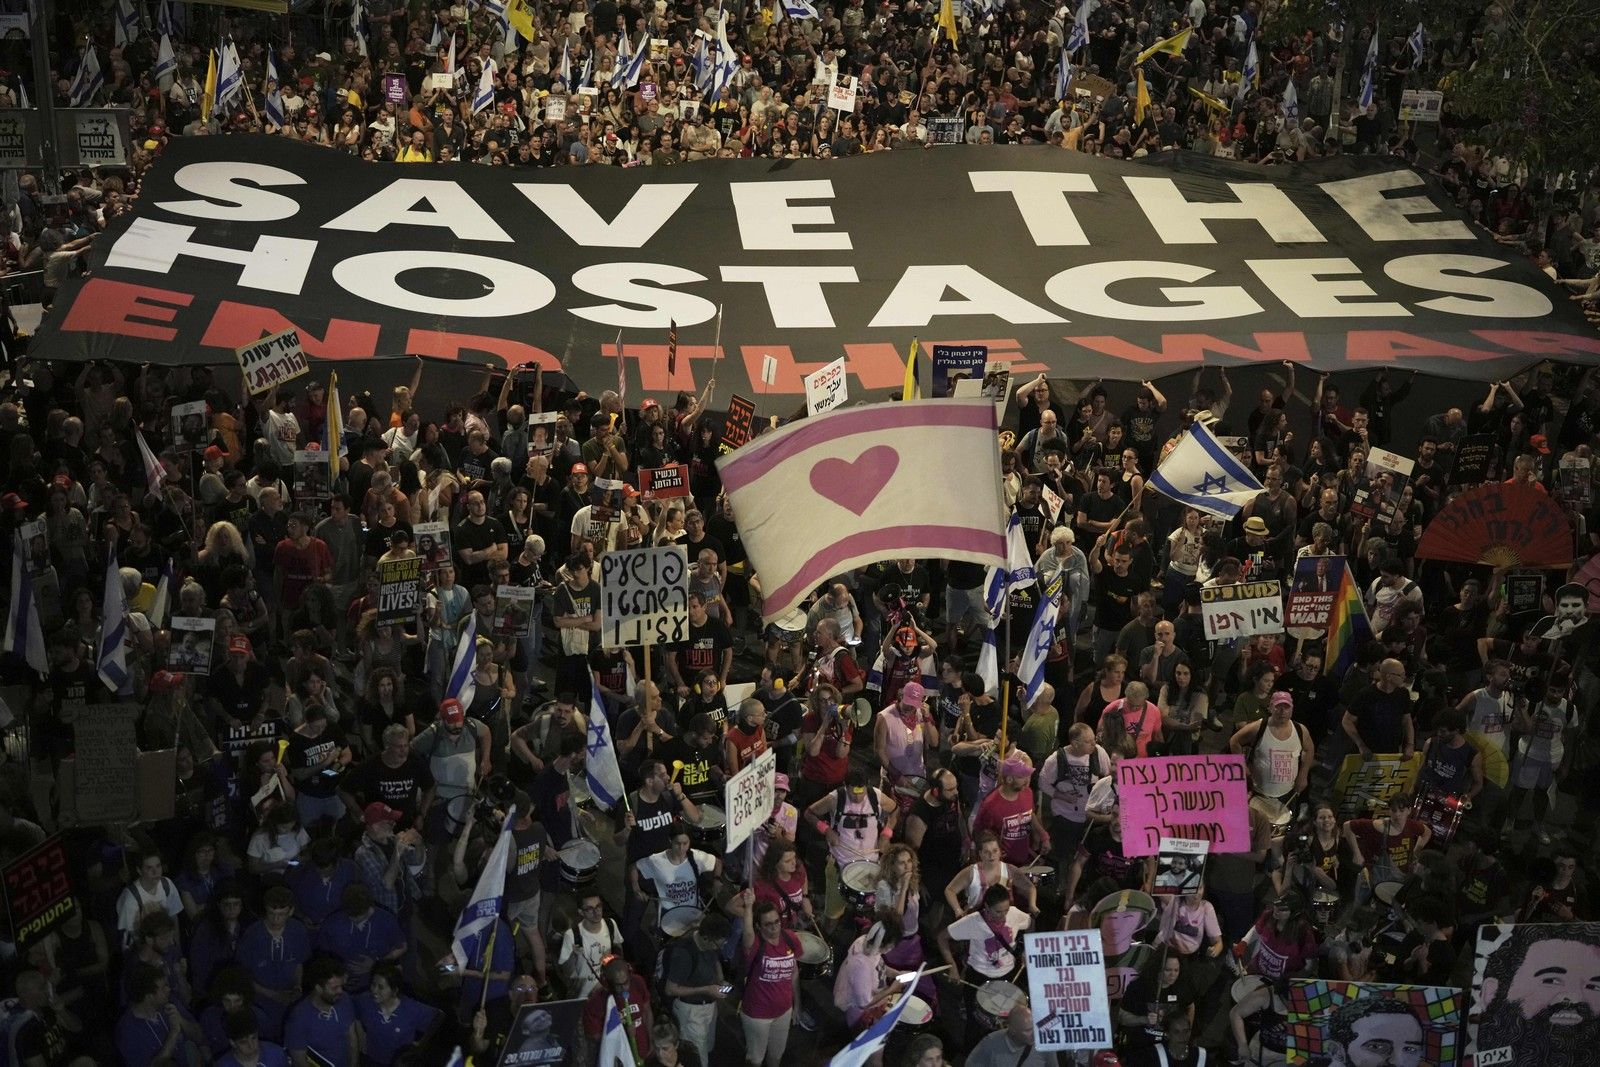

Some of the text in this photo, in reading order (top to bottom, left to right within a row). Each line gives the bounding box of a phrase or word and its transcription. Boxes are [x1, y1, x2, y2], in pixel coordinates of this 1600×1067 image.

[81, 135, 113, 148] אשם
[81, 150, 115, 158] במחדל
[155, 161, 1478, 250] SAVE THE
[104, 217, 1553, 328] HOSTAGES
[61, 278, 562, 374] END
[602, 338, 1050, 394] THE
[1064, 329, 1600, 364] WAR
[242, 331, 300, 367] האדישות
[973, 350, 984, 358] אין
[814, 365, 841, 389] כפכפים
[826, 378, 841, 396] עליך
[730, 401, 752, 428] ביבי
[652, 477, 682, 489] זה הזמן.
[655, 469, 678, 479] עכשיו
[384, 562, 396, 572] THE
[396, 561, 412, 571] COST
[602, 551, 684, 588] פושעים
[380, 591, 418, 612] LIVES!
[608, 586, 688, 617] השתלטו
[1209, 606, 1280, 635] אין זמן
[1290, 612, 1328, 624] WAR
[615, 616, 688, 646] עלינו
[684, 760, 710, 774] SEAL
[1120, 756, 1245, 785] במלחמת נצח
[683, 771, 709, 785] DEAL
[1145, 786, 1224, 818] תעשה לך
[1034, 935, 1090, 953] ביבי וזיני
[1029, 952, 1100, 968] במושב האחורי
[1056, 968, 1075, 982] נגד
[1044, 982, 1091, 998] עסקאות
[1048, 998, 1090, 1013] חטופים
[1058, 1014, 1083, 1028] בעד
[1039, 1026, 1106, 1044] מלחמת נצח
